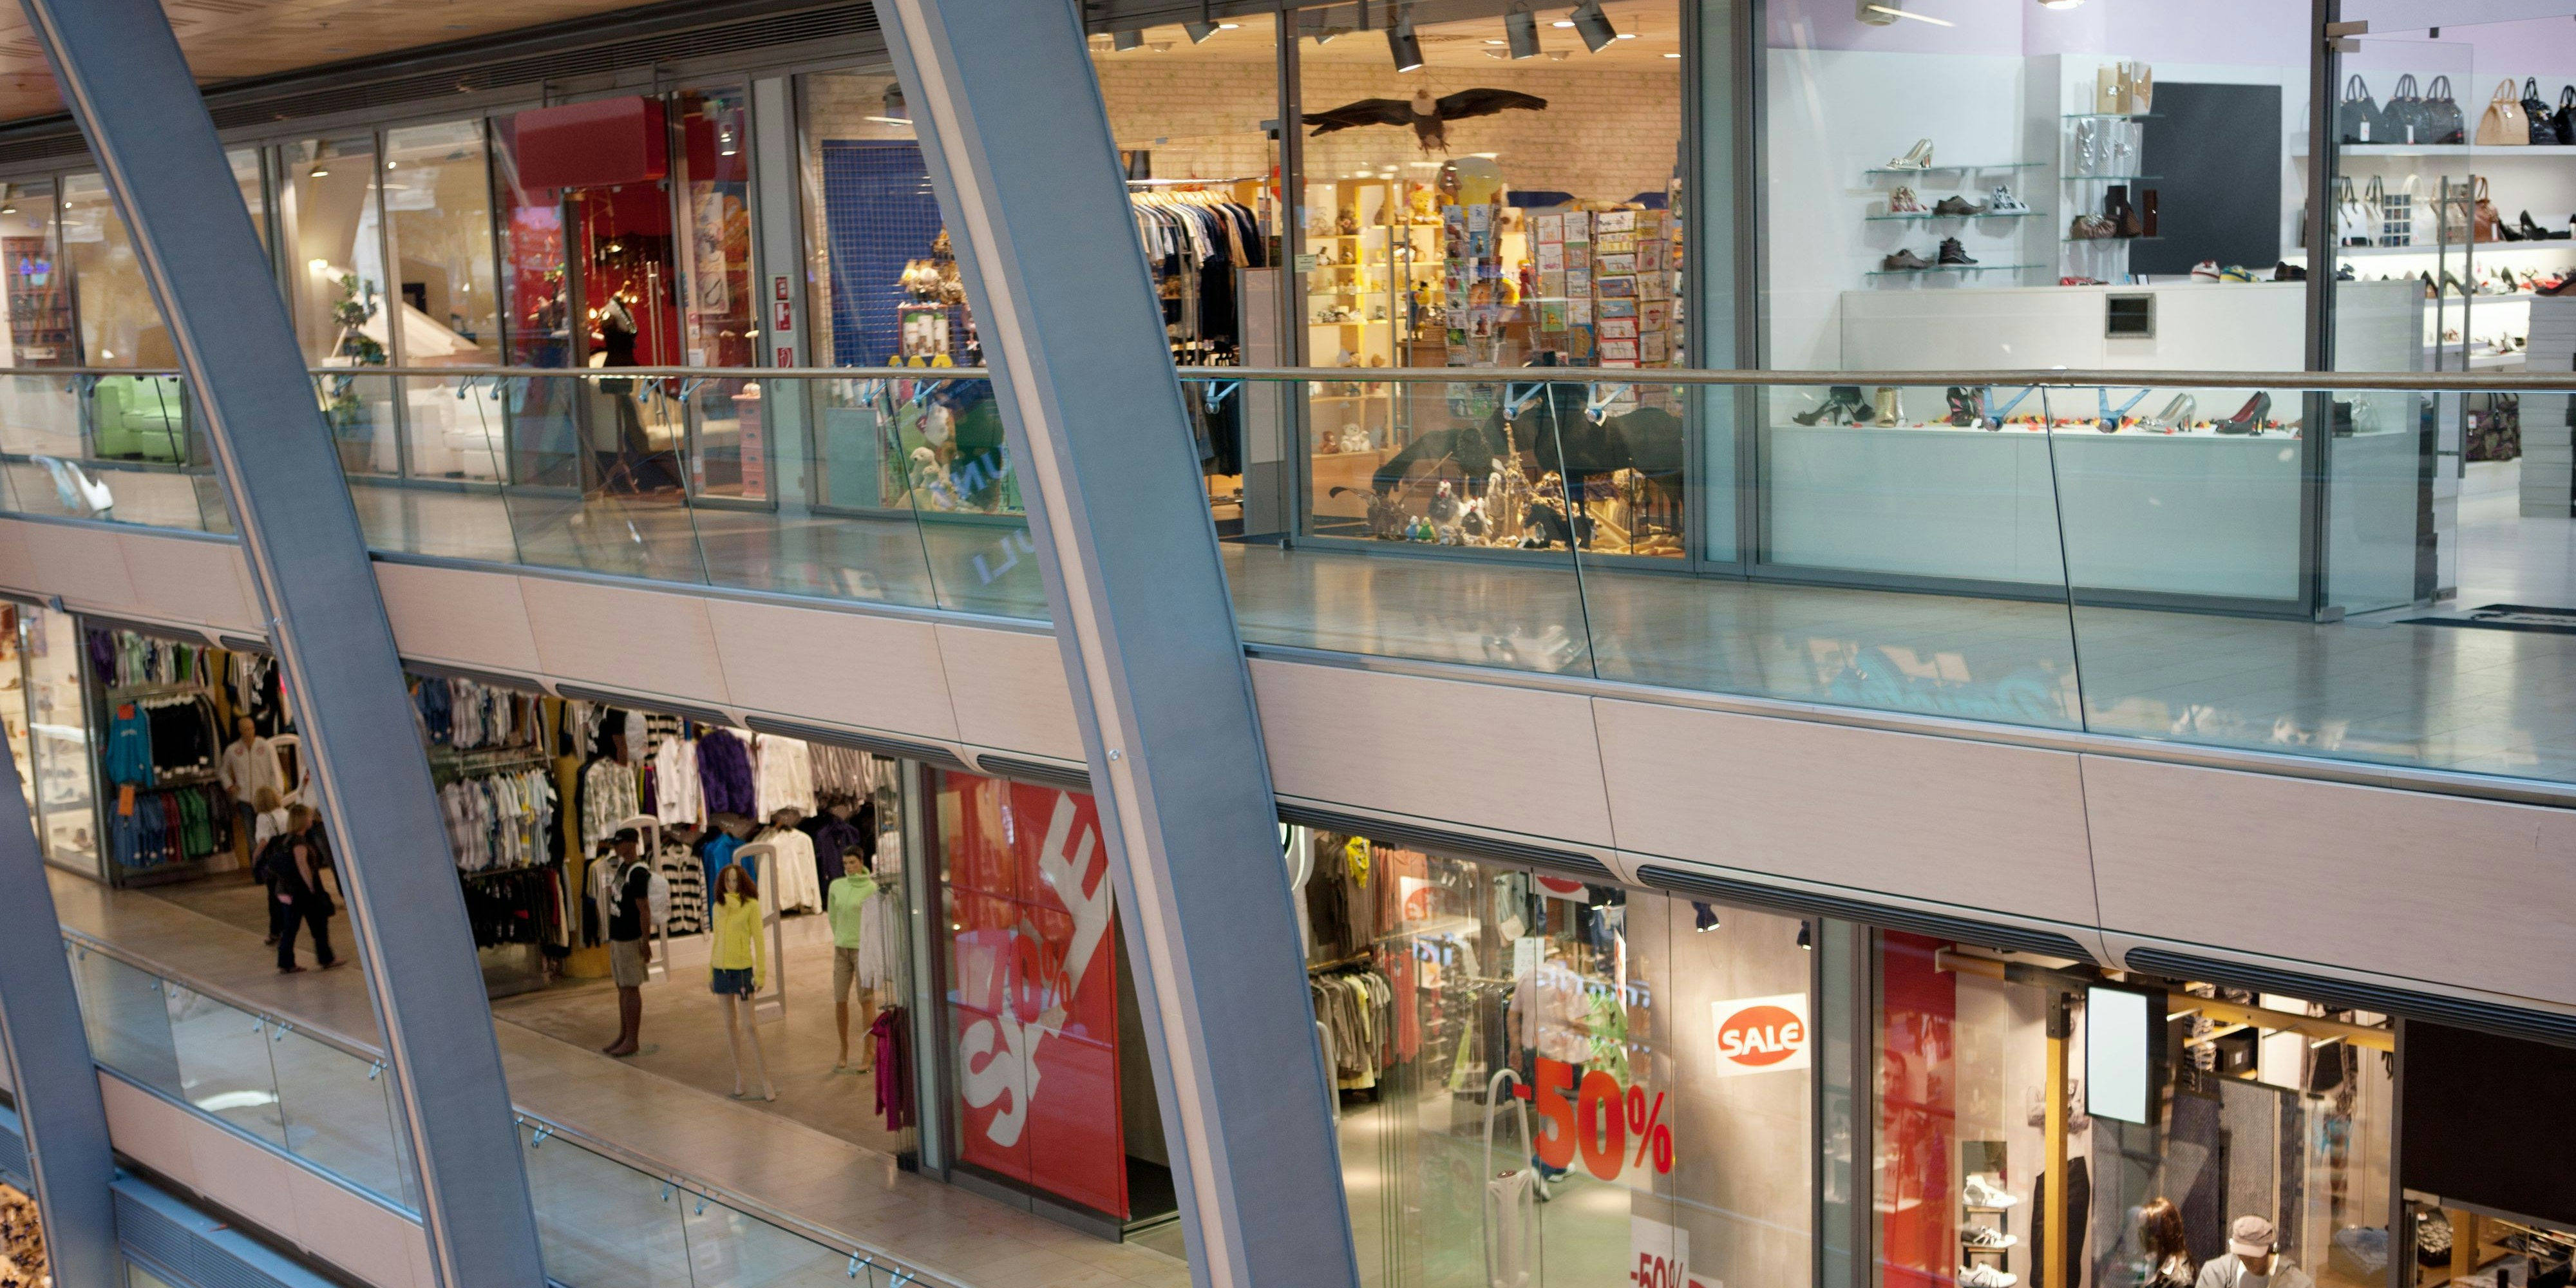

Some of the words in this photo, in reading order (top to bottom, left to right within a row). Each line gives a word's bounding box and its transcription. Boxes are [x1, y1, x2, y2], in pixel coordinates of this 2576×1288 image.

[960, 790, 1114, 1148] SALE
[1720, 1021, 1804, 1057] SALE
[1513, 1057, 1672, 1181] -50%
